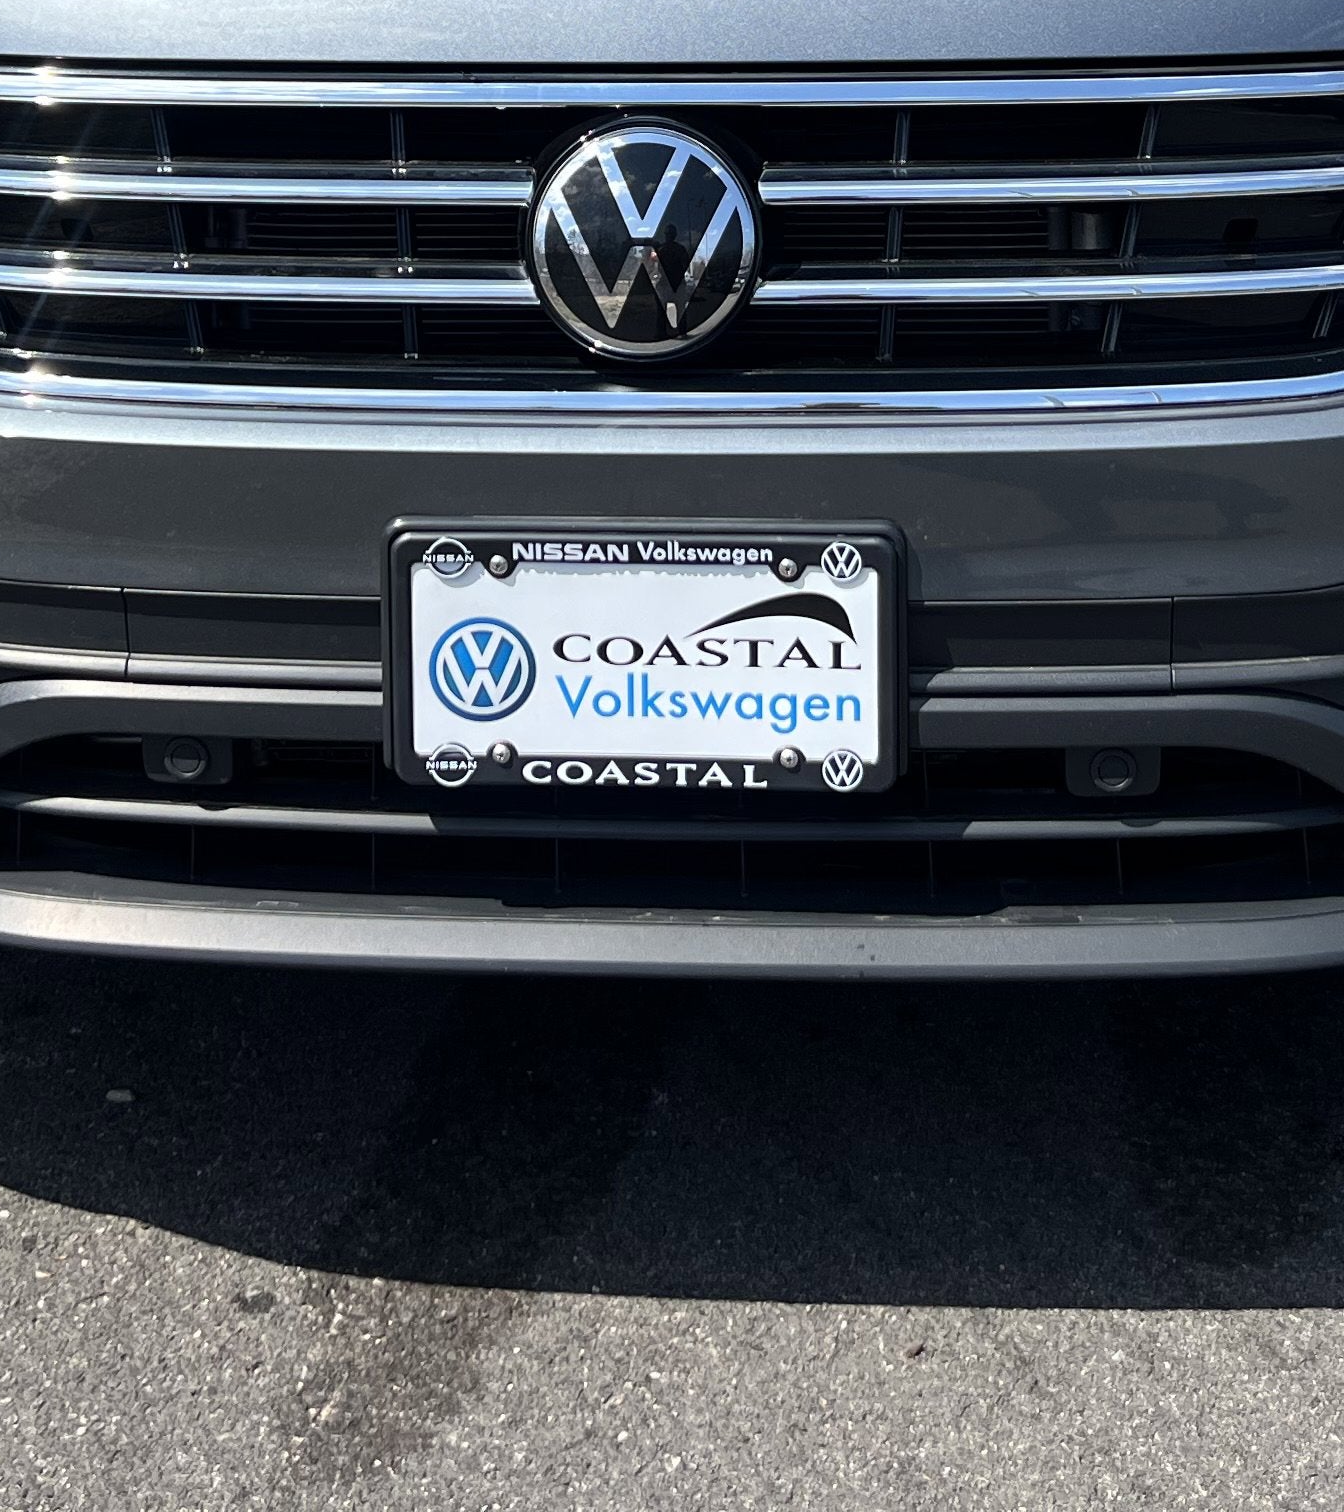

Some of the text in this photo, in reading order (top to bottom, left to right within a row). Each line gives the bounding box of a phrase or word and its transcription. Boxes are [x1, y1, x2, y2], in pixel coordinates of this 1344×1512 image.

[533, 126, 755, 355] VW
[422, 553, 474, 564] NISSAN
[513, 540, 773, 566] NISSAN Volkswagen
[552, 633, 862, 671] COASTAL
[429, 617, 537, 722] VW
[555, 672, 862, 734] Volkswagen
[425, 759, 477, 771] NISSAN
[522, 760, 768, 789] COASTAL
